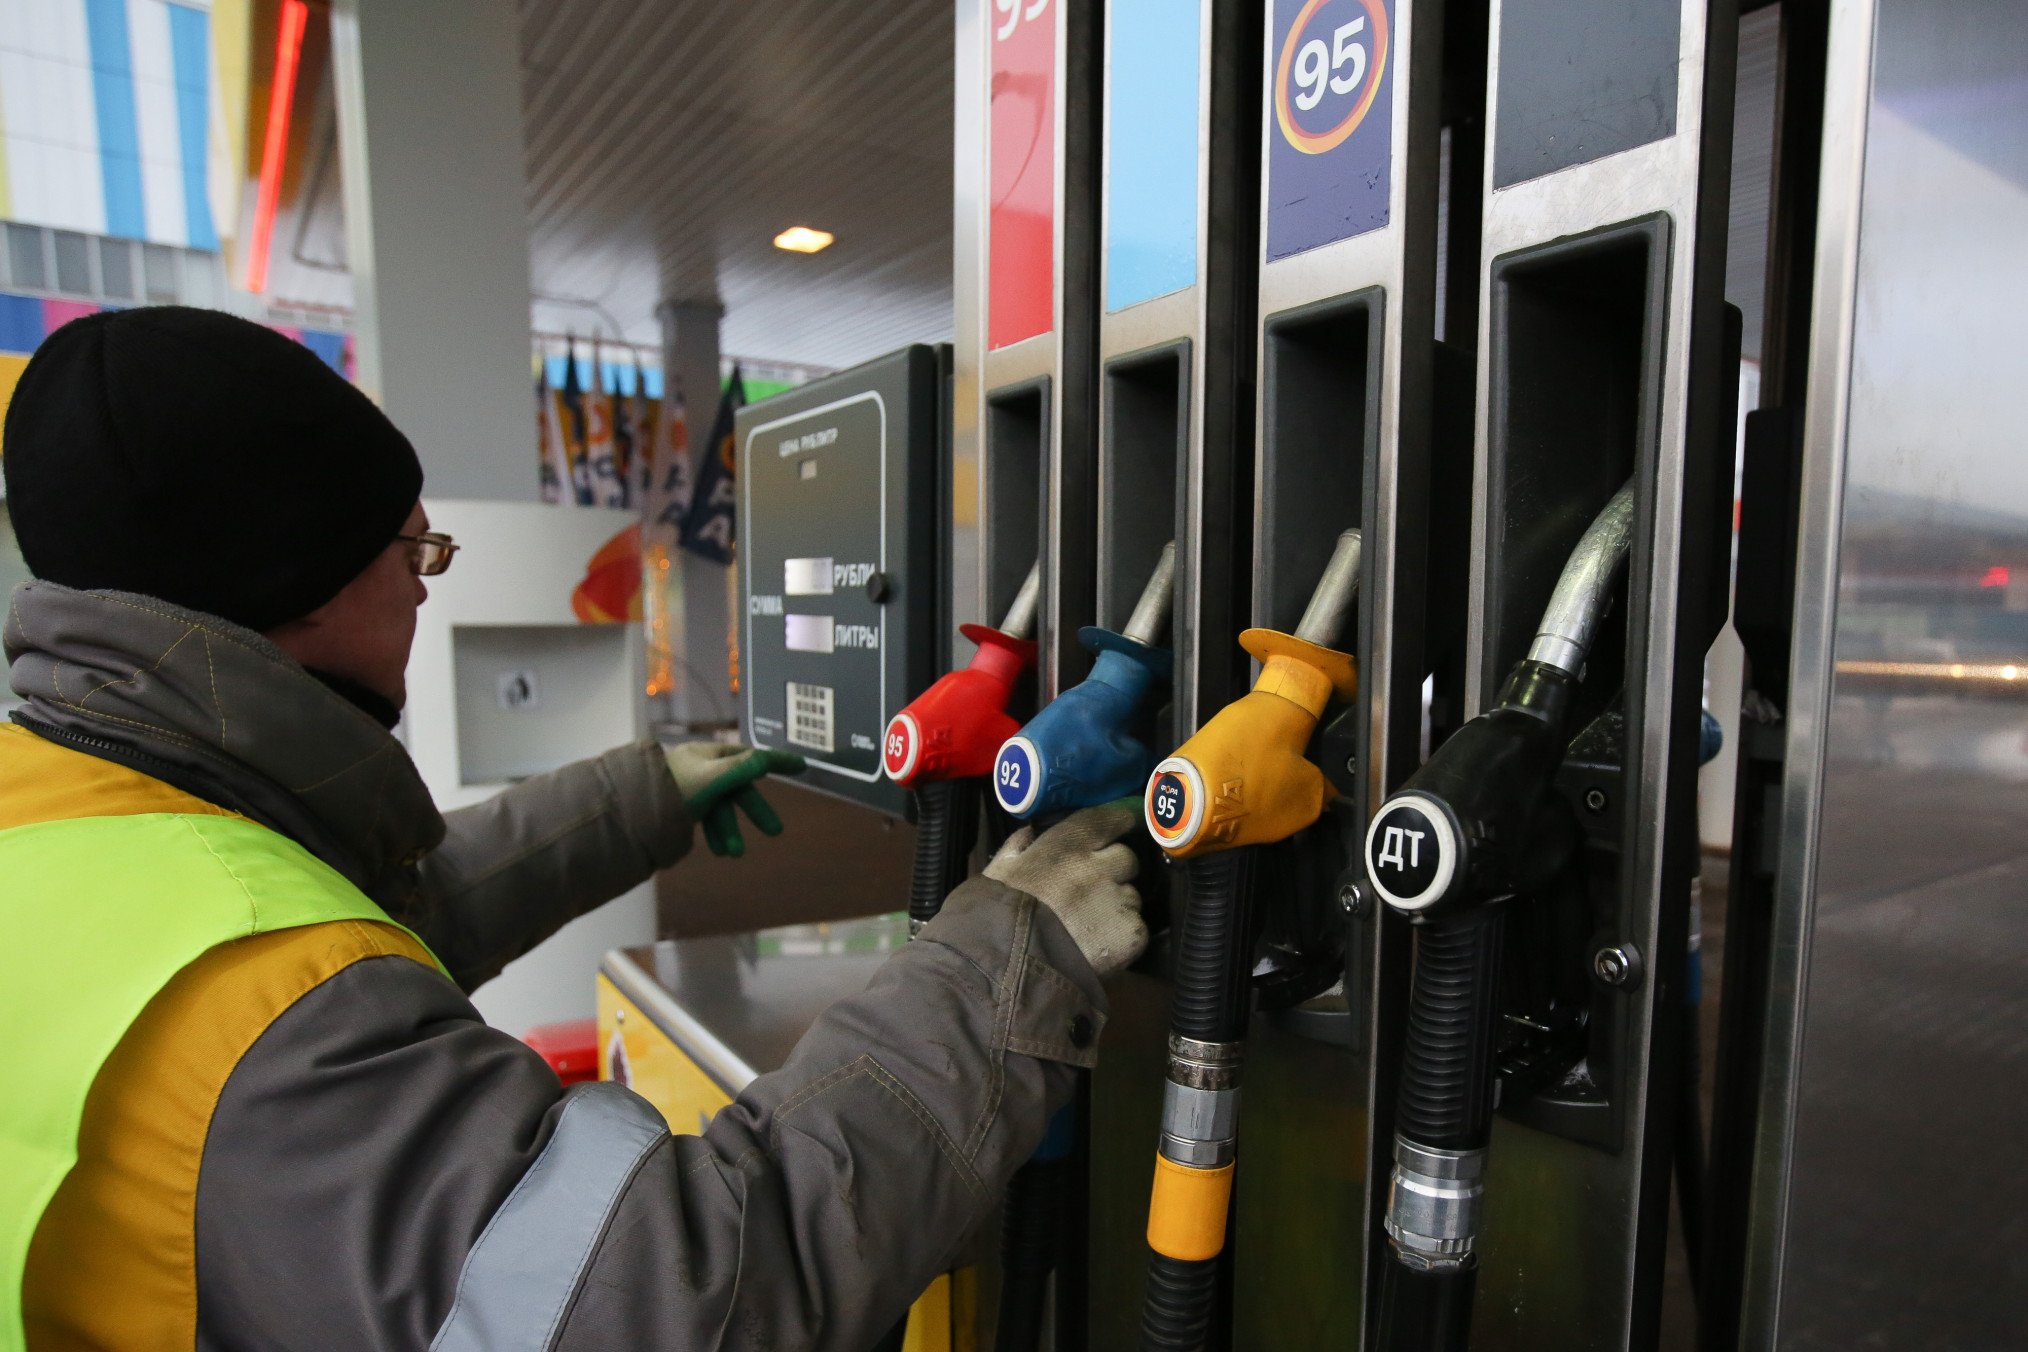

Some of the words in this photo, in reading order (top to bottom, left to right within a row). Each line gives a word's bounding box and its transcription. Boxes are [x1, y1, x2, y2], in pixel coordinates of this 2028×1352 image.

[1294, 15, 1366, 111] 95
[835, 624, 878, 649] ЛИТРЫ
[888, 733, 904, 758] 95
[1001, 760, 1021, 788] 92
[1157, 795, 1177, 819] 95
[1378, 826, 1425, 872] ДТ
